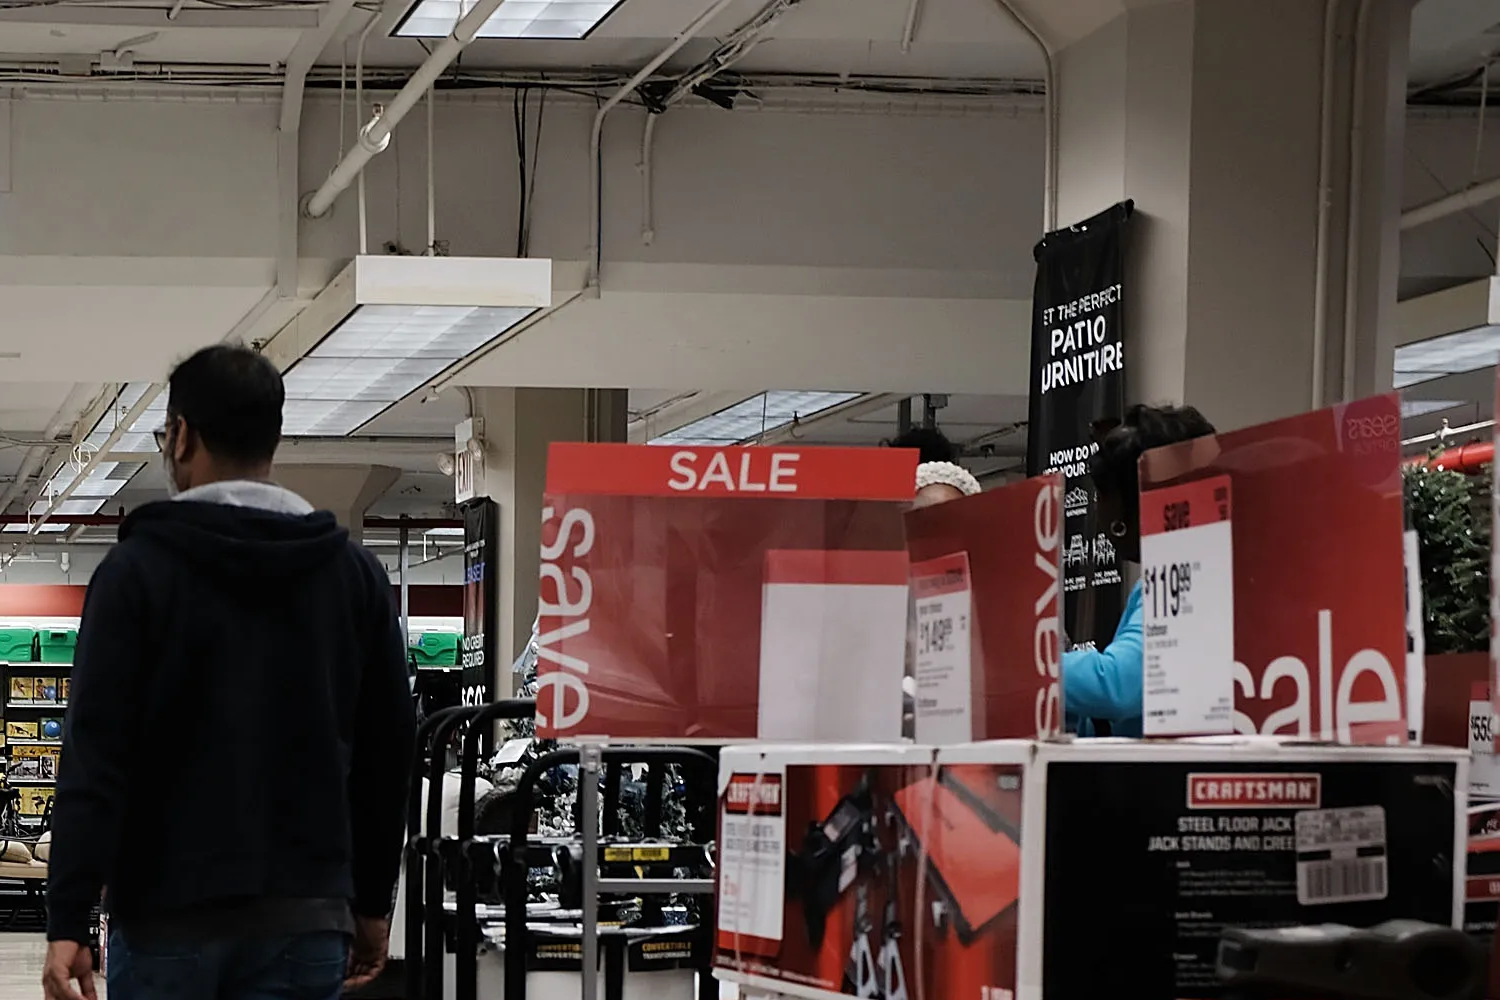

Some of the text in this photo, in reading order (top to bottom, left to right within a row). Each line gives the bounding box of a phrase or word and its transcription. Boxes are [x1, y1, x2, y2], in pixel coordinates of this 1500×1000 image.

[1044, 284, 1122, 326] ET THE PERFECT
[1050, 316, 1106, 356] PATIO
[1041, 342, 1123, 395] URNITURE
[668, 451, 799, 492] SALE
[1050, 444, 1089, 466] HOW DO
[537, 505, 595, 730] save
[1034, 483, 1063, 742] save
[1195, 781, 1312, 800] CRAFTSMAN
[1148, 835, 1297, 852] JACK STANDS AND CREE
[1178, 816, 1215, 832] STEEL
[1219, 816, 1259, 832] FLOOR
[1262, 816, 1292, 832] JACK
